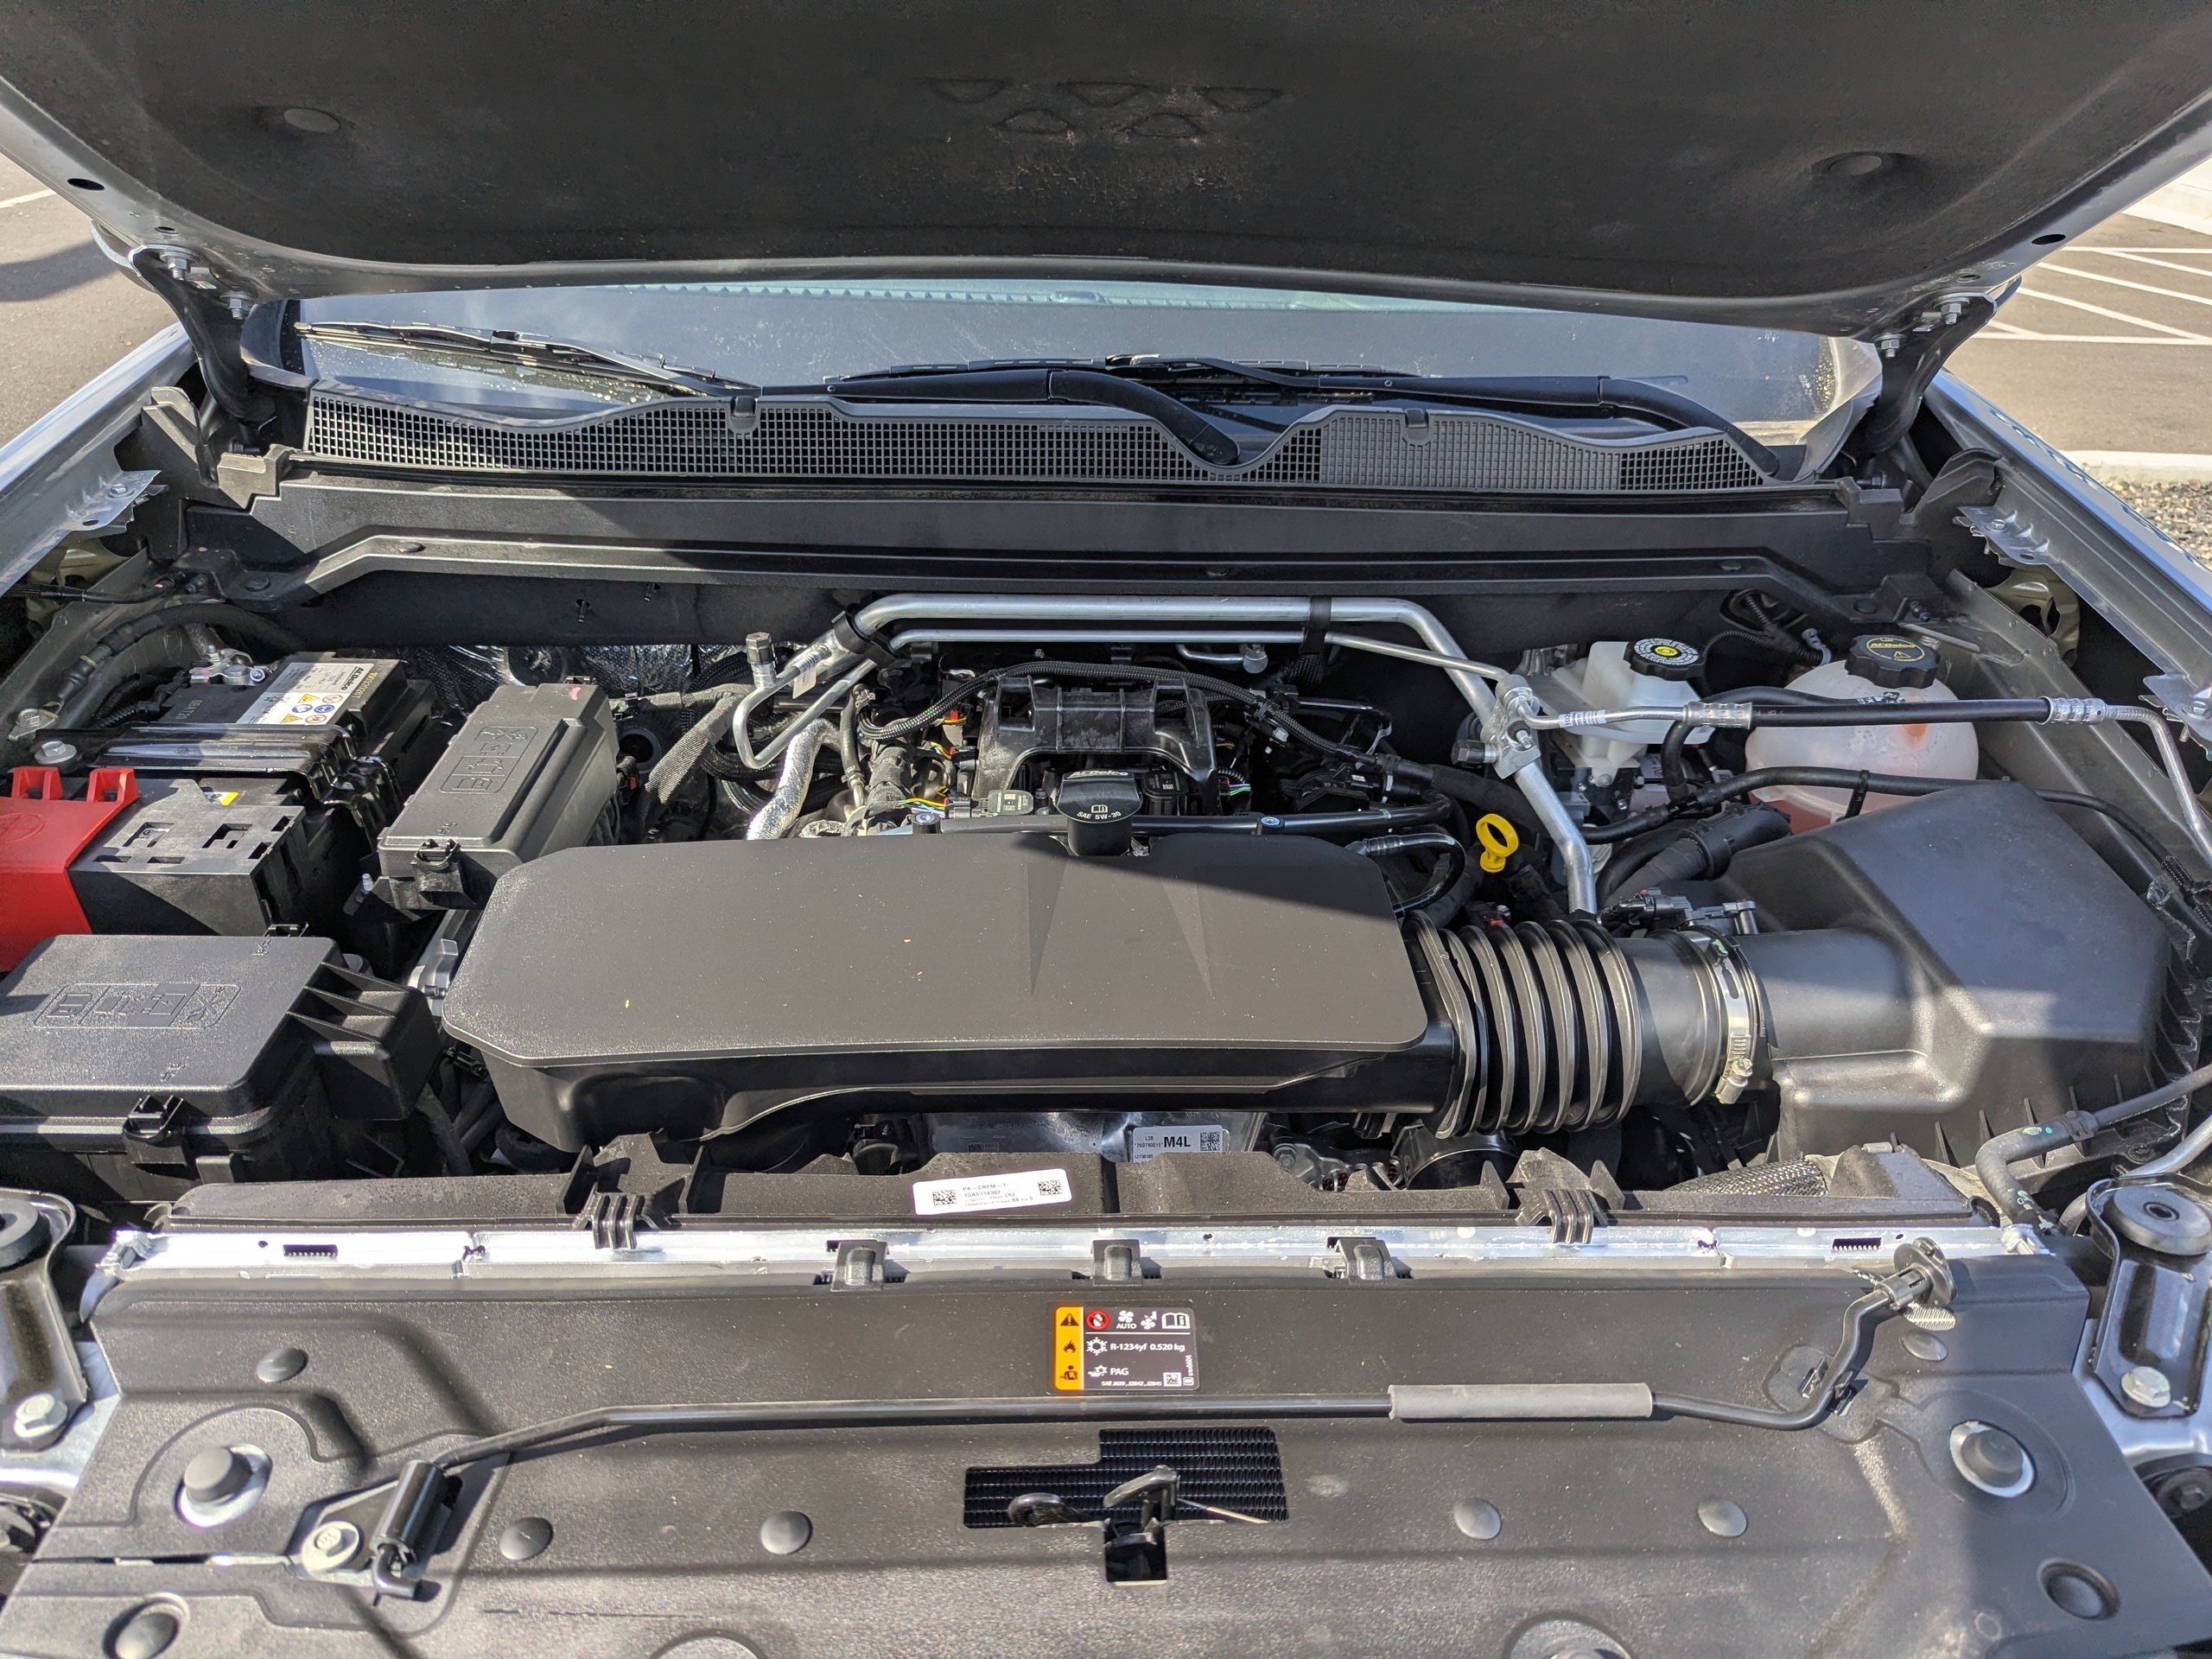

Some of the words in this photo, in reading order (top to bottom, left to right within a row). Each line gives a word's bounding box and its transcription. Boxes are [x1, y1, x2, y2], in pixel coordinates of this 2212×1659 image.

[1067, 770, 1128, 779] ACDelco
[1077, 810, 1092, 819] SAE
[1095, 811, 1122, 820] 5W-30
[1163, 1135, 1191, 1147] M4L
[1109, 1343, 1147, 1352] R-1234yf
[1174, 1344, 1185, 1352] kg
